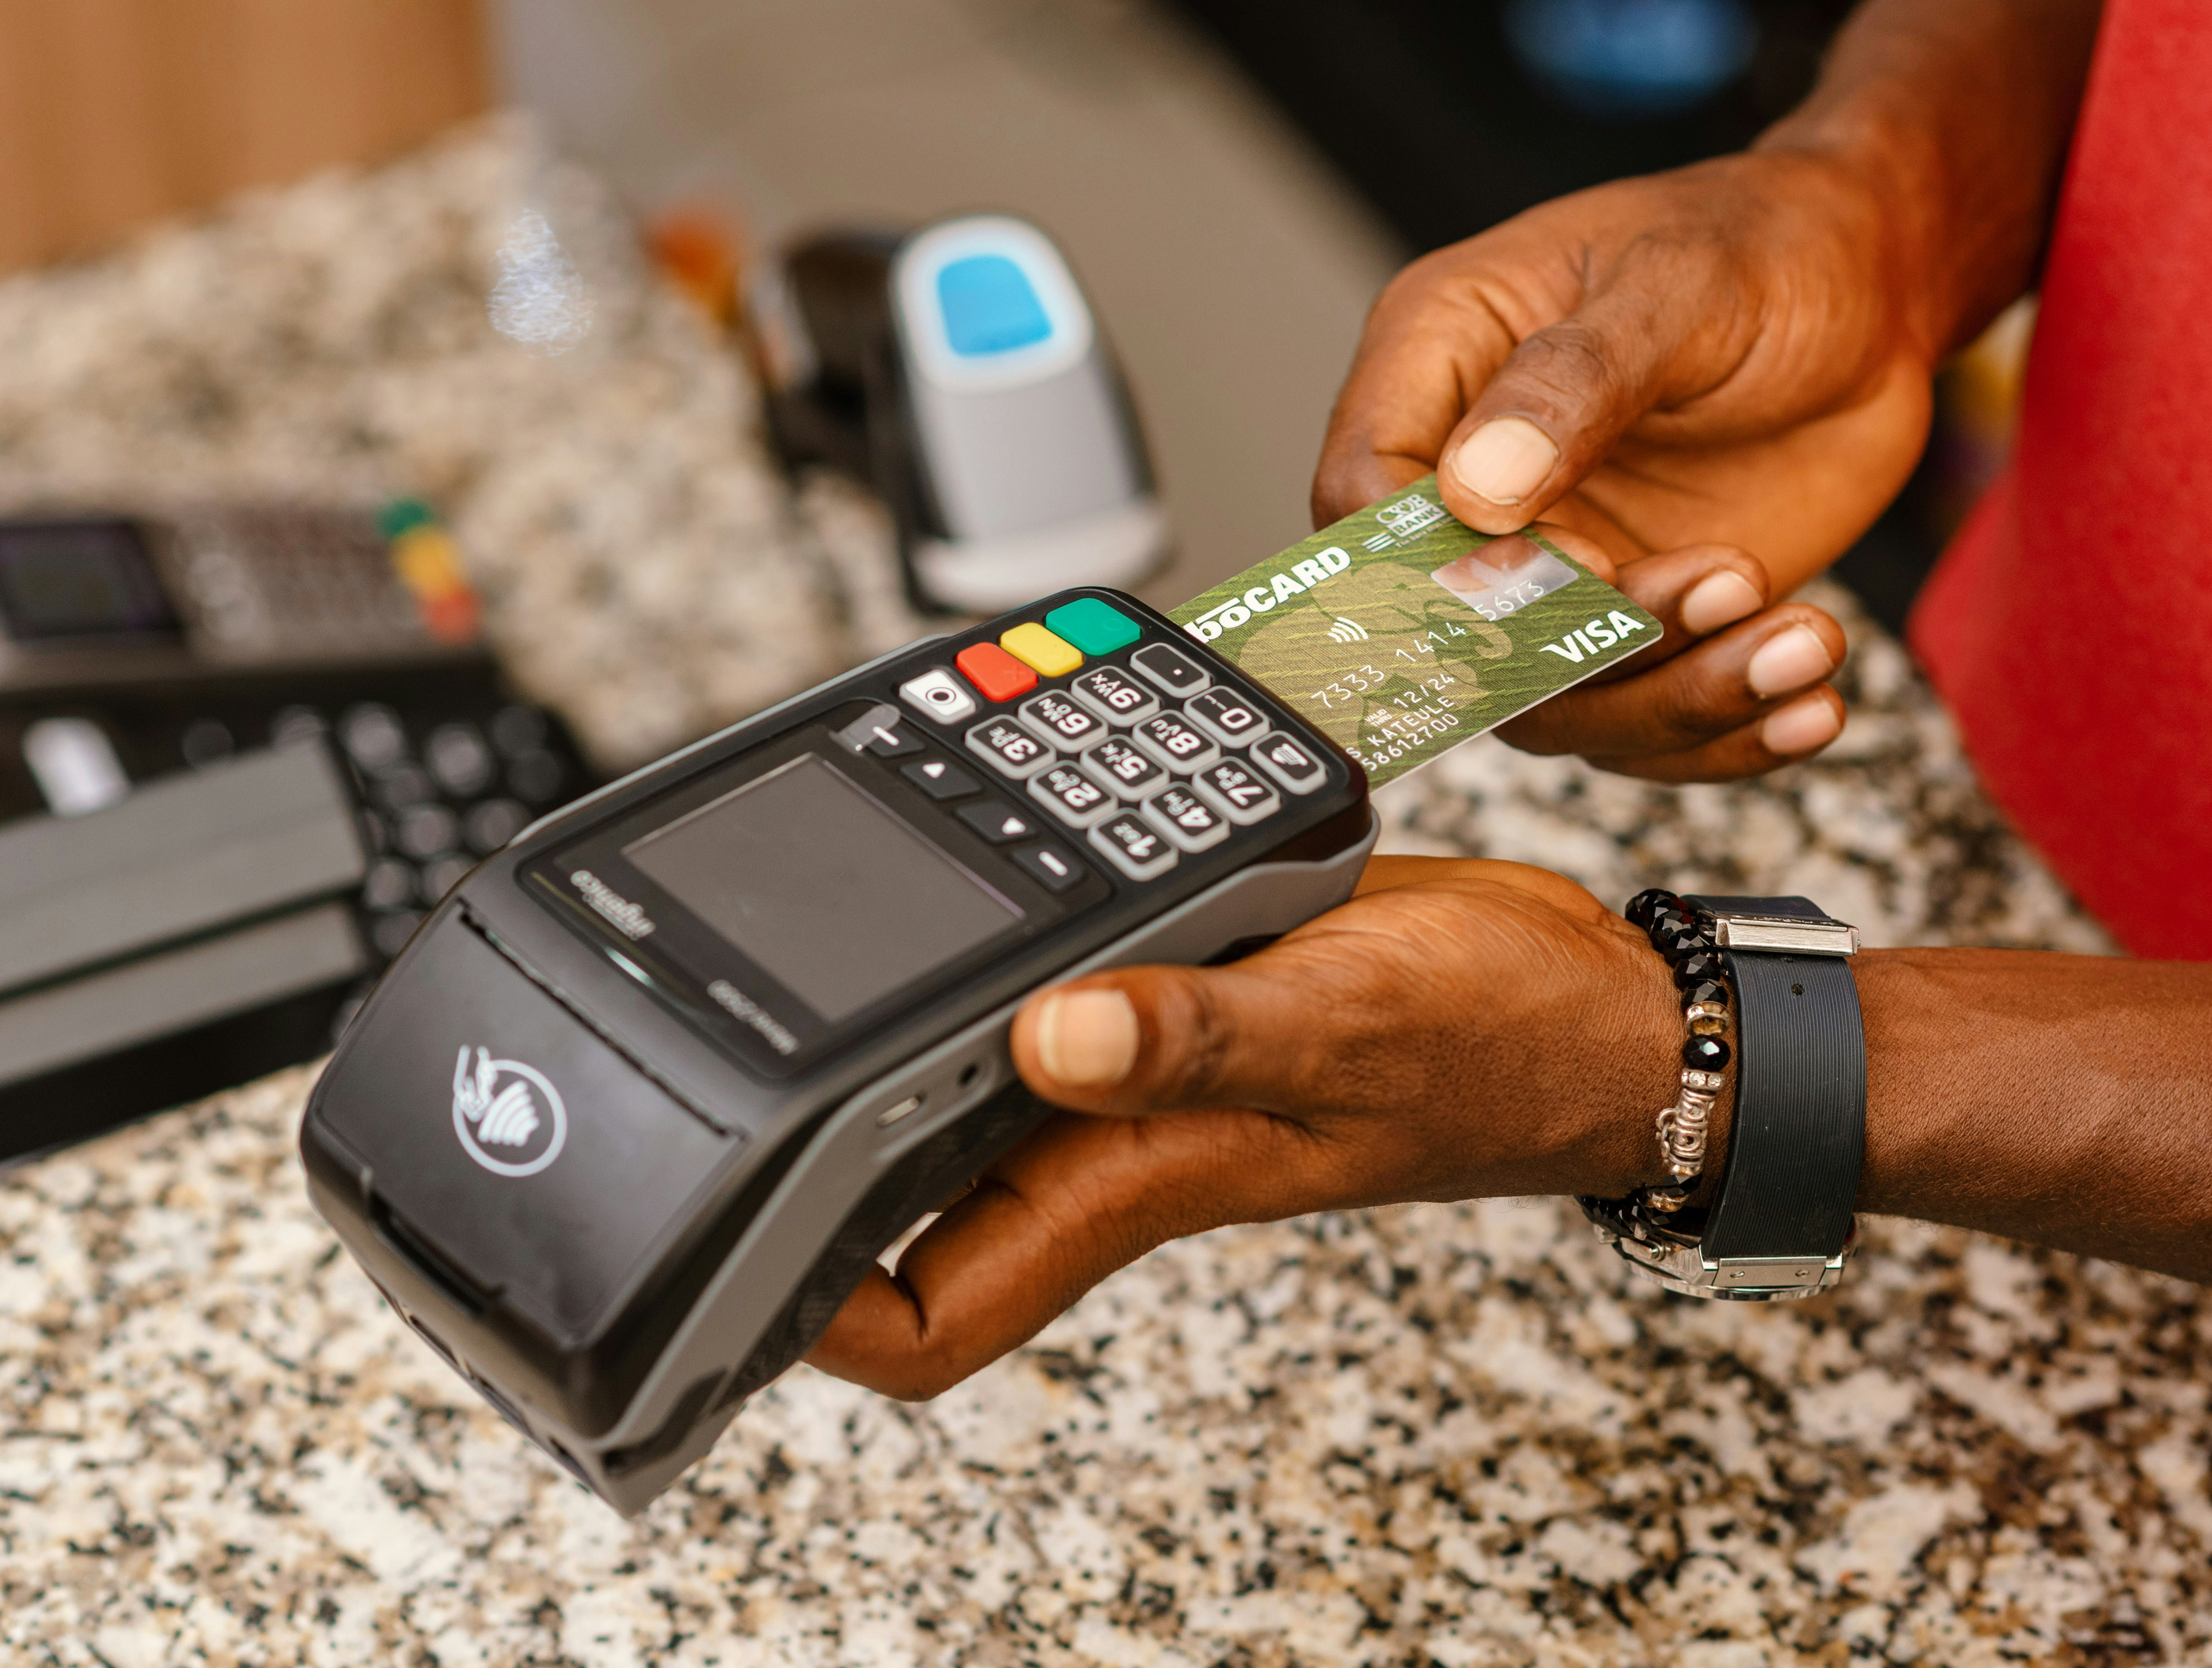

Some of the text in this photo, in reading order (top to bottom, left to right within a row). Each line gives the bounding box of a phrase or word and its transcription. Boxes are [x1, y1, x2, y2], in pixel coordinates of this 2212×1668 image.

[1393, 507, 1440, 534] BANK
[1311, 580, 1544, 708] 7333 1414 5673
[1538, 610, 1646, 663] VISA
[1108, 688, 1142, 709] 9
[1394, 674, 1455, 708] 12/24
[1057, 713, 1091, 734] 6
[1364, 709, 1387, 722] VALID
[1371, 714, 1393, 727] THRU
[1346, 696, 1455, 759] S KATEULE
[1003, 738, 1038, 761] 3
[1166, 732, 1201, 754] 8
[1361, 714, 1459, 771] 58612700
[1113, 755, 1148, 780] 5
[1064, 782, 1102, 807] 2
[1227, 786, 1264, 806] 7
[1178, 806, 1213, 827] 4
[1127, 834, 1157, 856] 1
